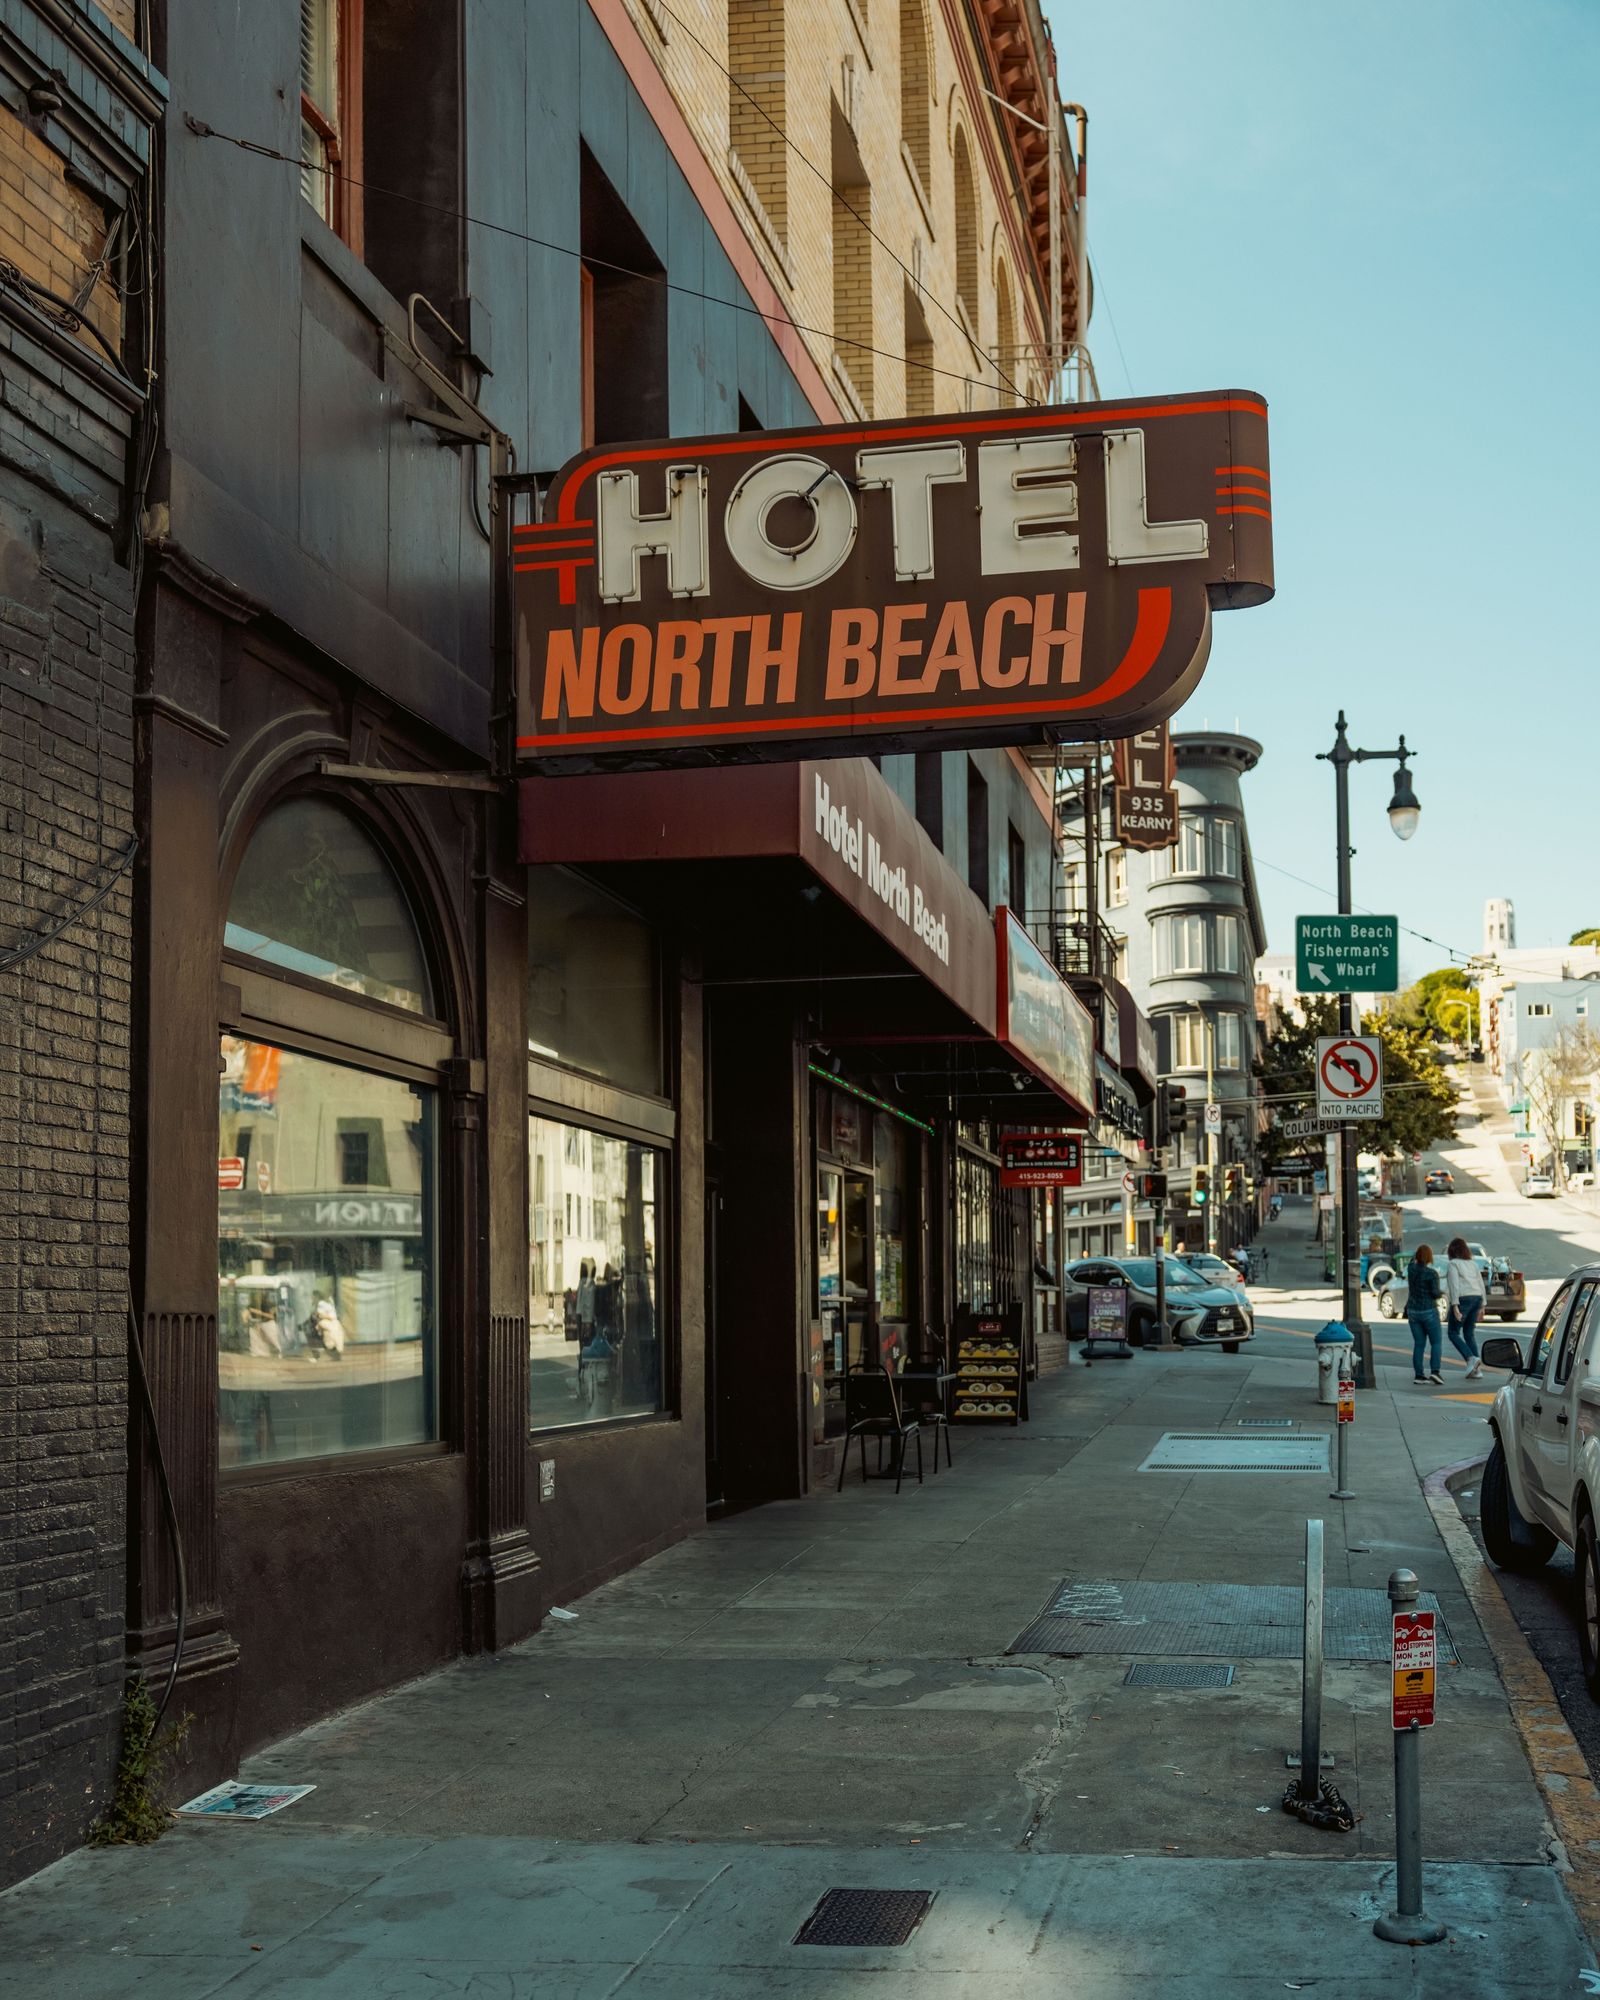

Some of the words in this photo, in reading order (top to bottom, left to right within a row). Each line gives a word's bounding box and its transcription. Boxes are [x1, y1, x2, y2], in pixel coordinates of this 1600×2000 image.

[597, 427, 1209, 604] HOTEL
[541, 612, 801, 720] NORTH
[824, 591, 1087, 701] BEACH
[1131, 796, 1164, 812] 935
[1121, 814, 1173, 831] KEARNY
[815, 772, 862, 879] Hotel
[868, 832, 910, 926] North
[913, 884, 949, 967] Beach
[1302, 924, 1341, 938] North
[1351, 924, 1393, 938] Beach
[1305, 944, 1389, 957] Fisherman's
[1336, 963, 1376, 976] Wharf
[1321, 1104, 1341, 1114] INTO
[1346, 1103, 1379, 1114] PACIFIC
[1285, 1120, 1340, 1137] COLUMBUS
[1396, 1652, 1412, 1660] MON
